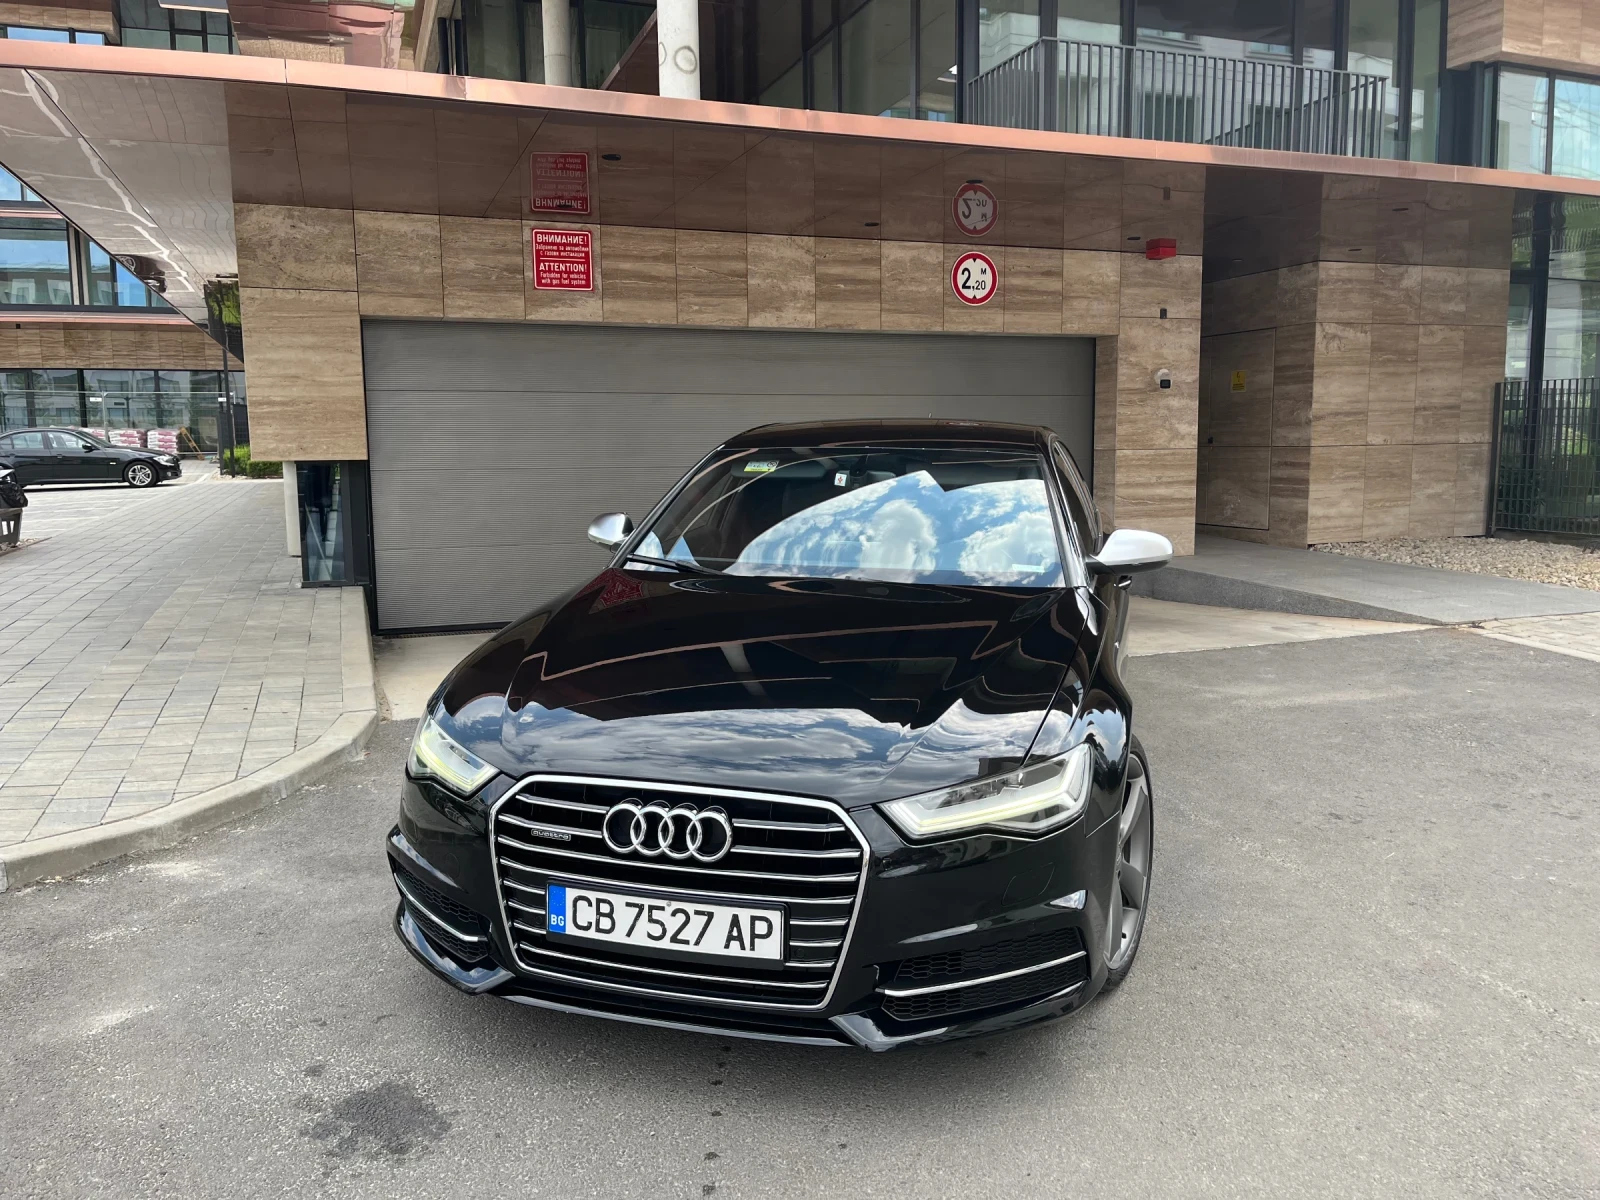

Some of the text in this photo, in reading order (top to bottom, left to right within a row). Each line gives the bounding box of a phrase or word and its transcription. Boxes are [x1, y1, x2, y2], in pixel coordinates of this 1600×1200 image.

[536, 234, 587, 245] ВНИМАНИЕ!
[539, 263, 587, 272] ATTENTION!
[550, 895, 774, 951] BG CB 7527 AP
